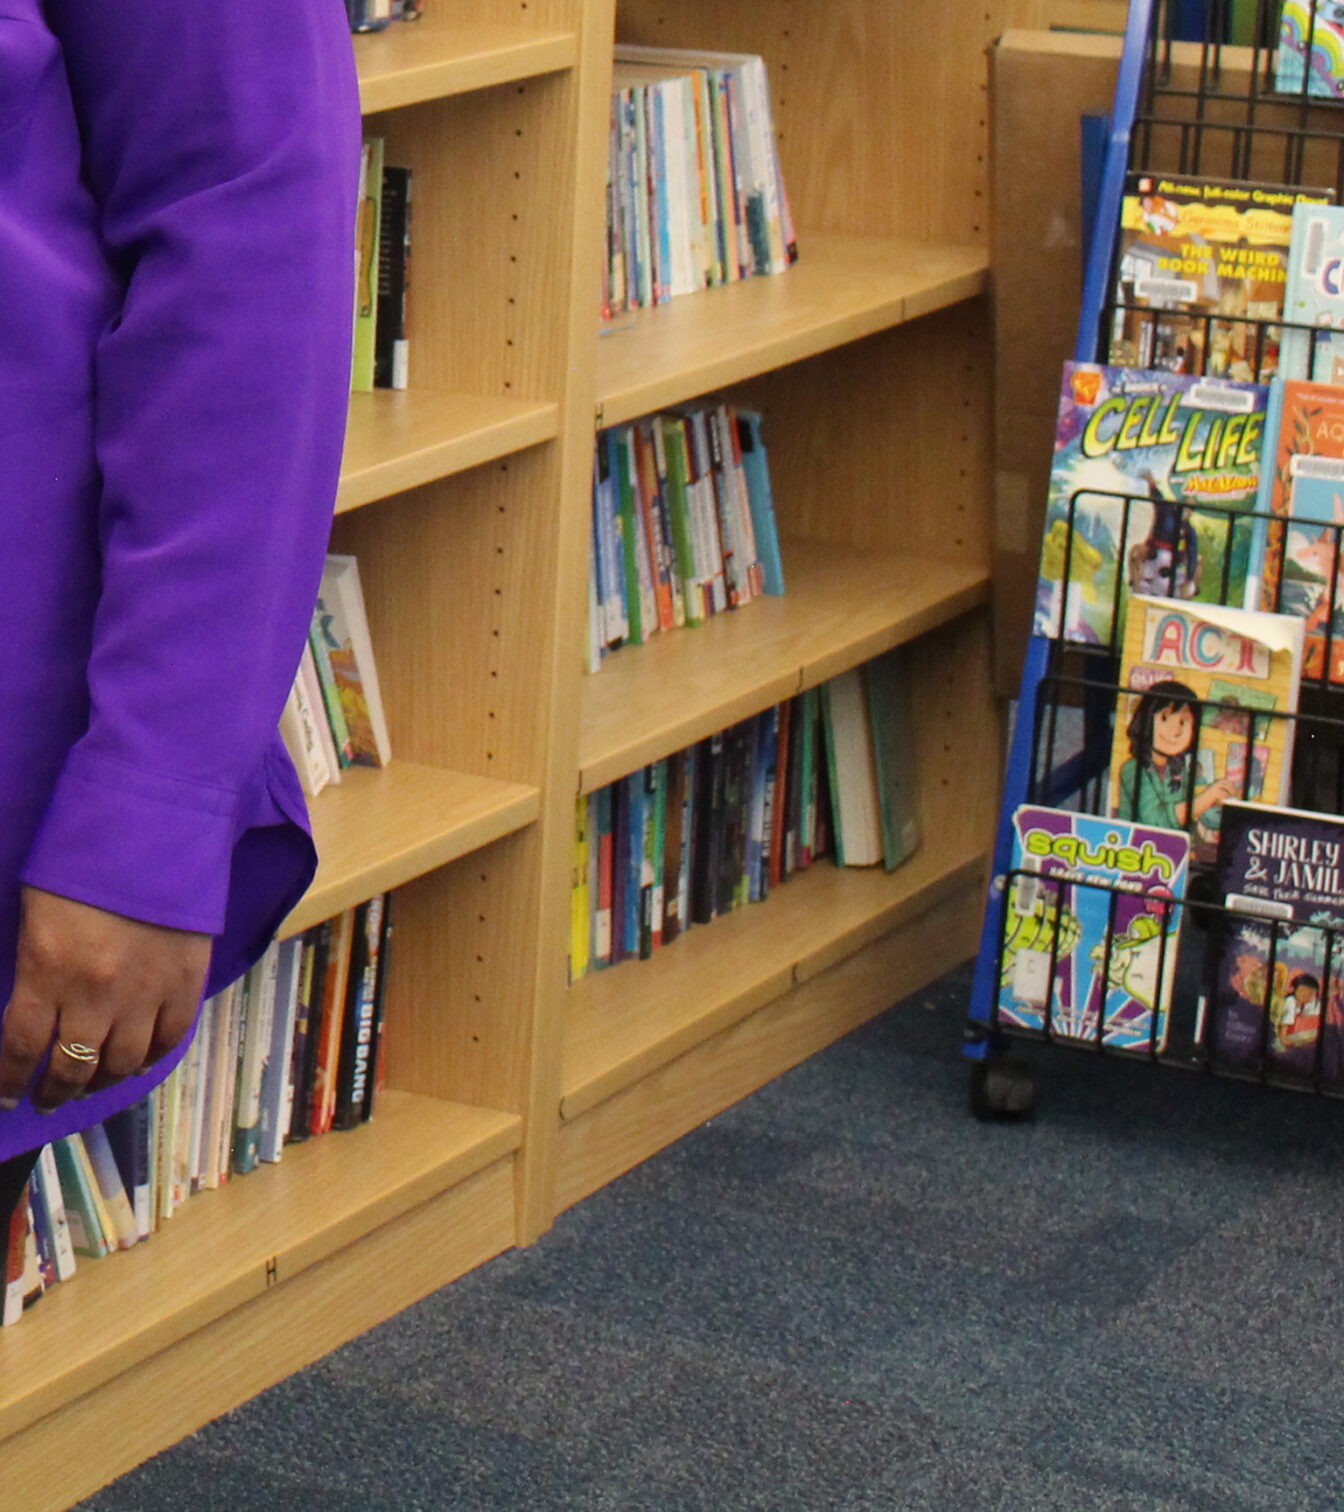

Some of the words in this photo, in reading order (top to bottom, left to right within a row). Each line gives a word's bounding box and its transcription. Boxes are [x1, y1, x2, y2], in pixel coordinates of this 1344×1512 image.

[1157, 257, 1209, 274] BOOK
[1217, 264, 1287, 282] MACHIN
[1181, 243, 1212, 259] THE
[1220, 247, 1280, 267] WEIRD
[1081, 392, 1182, 459] CELL
[1175, 411, 1266, 474] LIFE
[1150, 612, 1257, 674] ACT
[1025, 830, 1174, 880] squish
[1247, 829, 1341, 867] SHIRLEY
[1273, 862, 1344, 894] JAMIL
[358, 1003, 373, 1044] BIG
[351, 1045, 371, 1103] BANG
